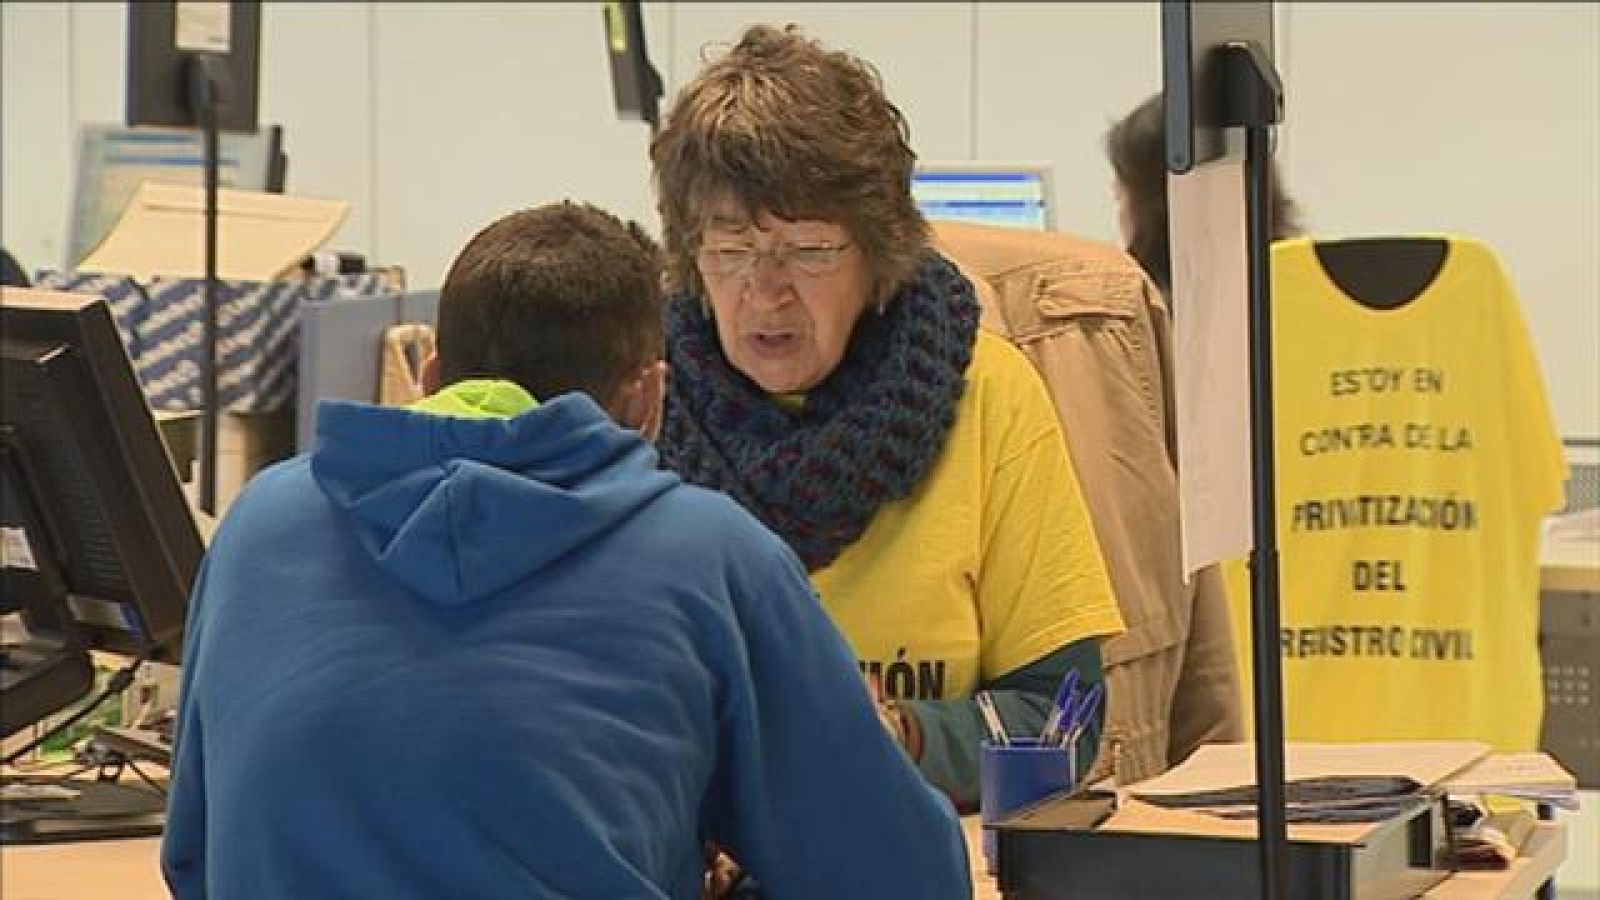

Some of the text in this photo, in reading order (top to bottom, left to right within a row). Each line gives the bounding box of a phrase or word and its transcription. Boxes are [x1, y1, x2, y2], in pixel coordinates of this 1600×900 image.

[1330, 367, 1442, 396] ESTOY EN
[1300, 424, 1395, 456] CONTRA
[1439, 426, 1473, 452] LA
[1291, 491, 1478, 533] PRIVTIZACIÓN
[1352, 560, 1406, 591] DEL
[1279, 624, 1402, 660] REISTRO
